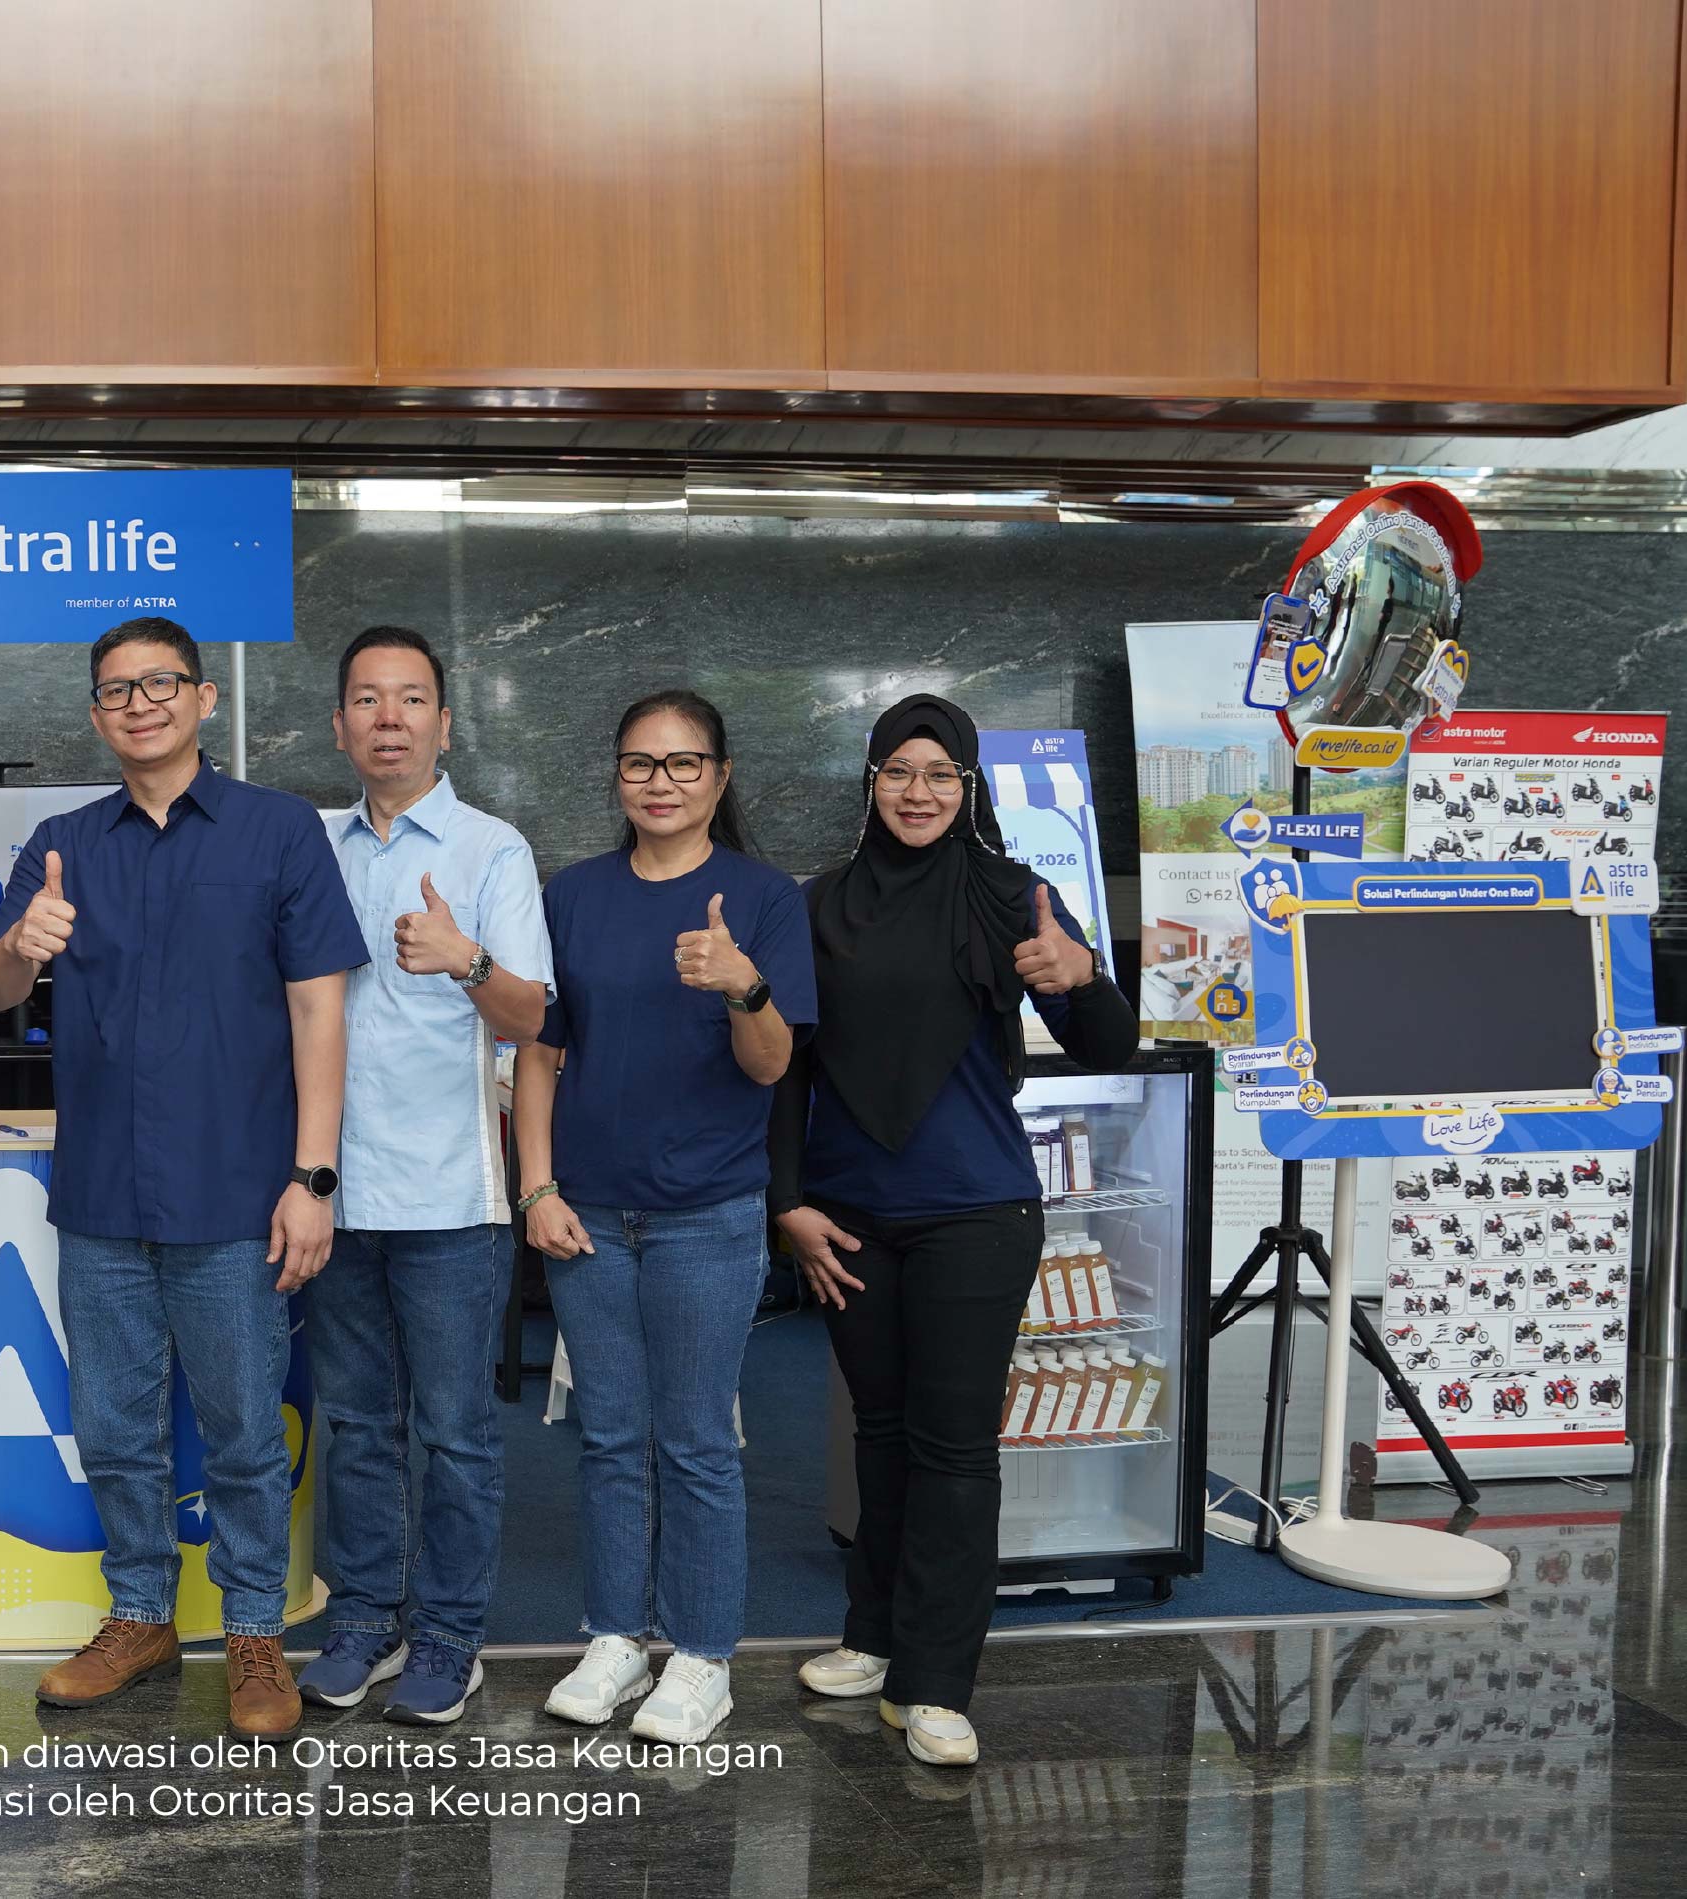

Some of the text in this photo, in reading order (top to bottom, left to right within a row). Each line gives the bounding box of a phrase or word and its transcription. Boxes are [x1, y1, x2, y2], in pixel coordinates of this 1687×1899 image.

[88, 519, 176, 571] life
[1327, 530, 1366, 591] Asuransi
[1367, 514, 1400, 537] Online
[65, 596, 177, 608] member of ASTRA
[1443, 726, 1659, 743] astra motor HONDA
[1044, 737, 1065, 745] astra
[1453, 756, 1621, 770] Varian Reguler Motor Honda
[1276, 823, 1360, 838] FLEXI LIFE
[1550, 828, 1601, 837] Genio
[1035, 853, 1078, 866] 2026
[1158, 868, 1231, 880] Contact us
[1609, 863, 1649, 878] astra
[1363, 887, 1535, 900] Solusi Perlindungan Under One Roof
[1610, 880, 1634, 897] life
[1204, 889, 1233, 901] +62
[1627, 1032, 1677, 1041] Perlindungan
[1228, 1051, 1282, 1062] Perlindungan
[1229, 1059, 1256, 1069] Syariah
[1235, 1072, 1258, 1084] FLE
[1635, 1080, 1661, 1089] Dana
[1239, 1089, 1295, 1099] Perlindungan
[1636, 1089, 1668, 1098] Pensiun
[1239, 1099, 1281, 1109] Kumpulan
[1430, 1112, 1497, 1137] Love Life
[1229, 1148, 1271, 1157] to Schoo
[1247, 1161, 1277, 1170] Finest
